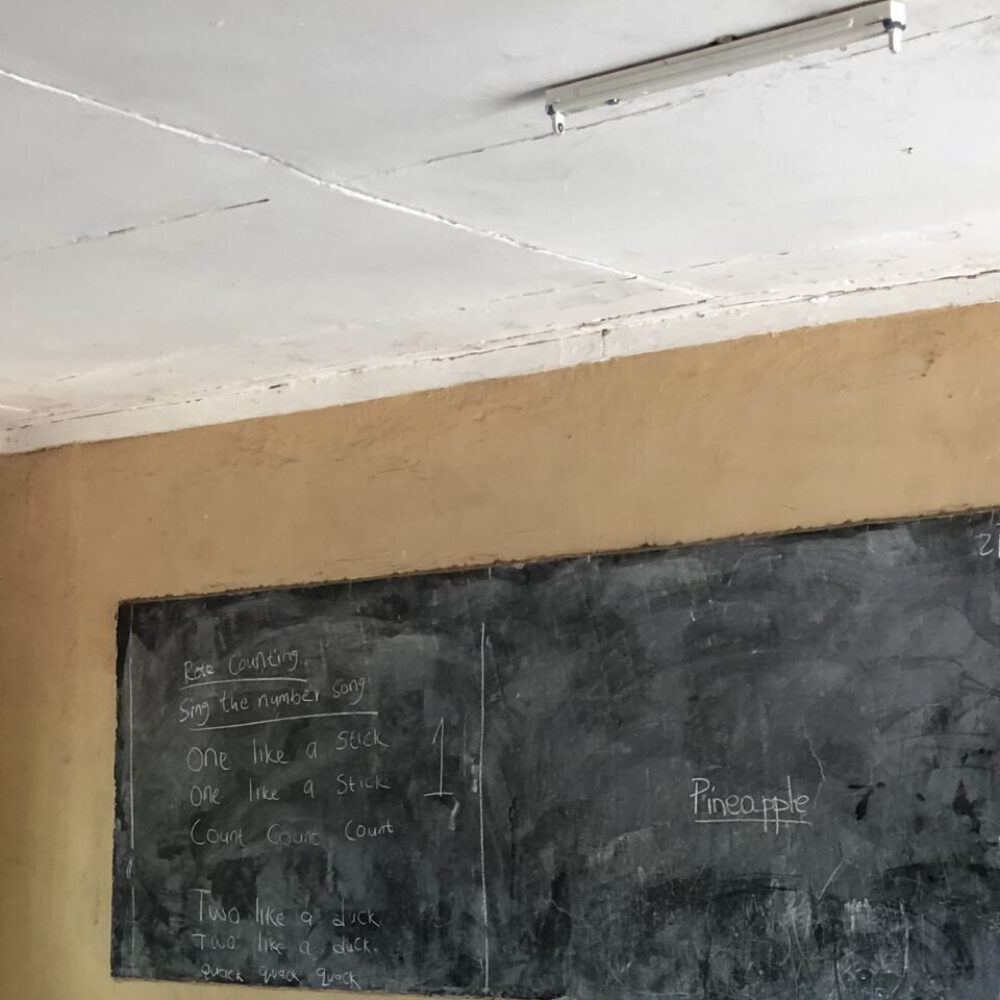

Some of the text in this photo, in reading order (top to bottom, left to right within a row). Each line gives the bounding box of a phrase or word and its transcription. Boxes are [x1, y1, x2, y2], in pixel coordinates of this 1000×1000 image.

[220, 691, 250, 712] the
[258, 688, 321, 707] number
[252, 738, 288, 764] like
[306, 741, 317, 759] a
[249, 778, 280, 801] like
[303, 779, 314, 798] a
[690, 776, 809, 834] Pineapple
[190, 819, 246, 847] Count
[344, 819, 394, 841] Count
[193, 888, 240, 924] Two
[255, 897, 285, 926] like
[300, 911, 312, 926] a
[191, 933, 236, 950] Two
[258, 929, 285, 954] like
[300, 942, 311, 955] a
